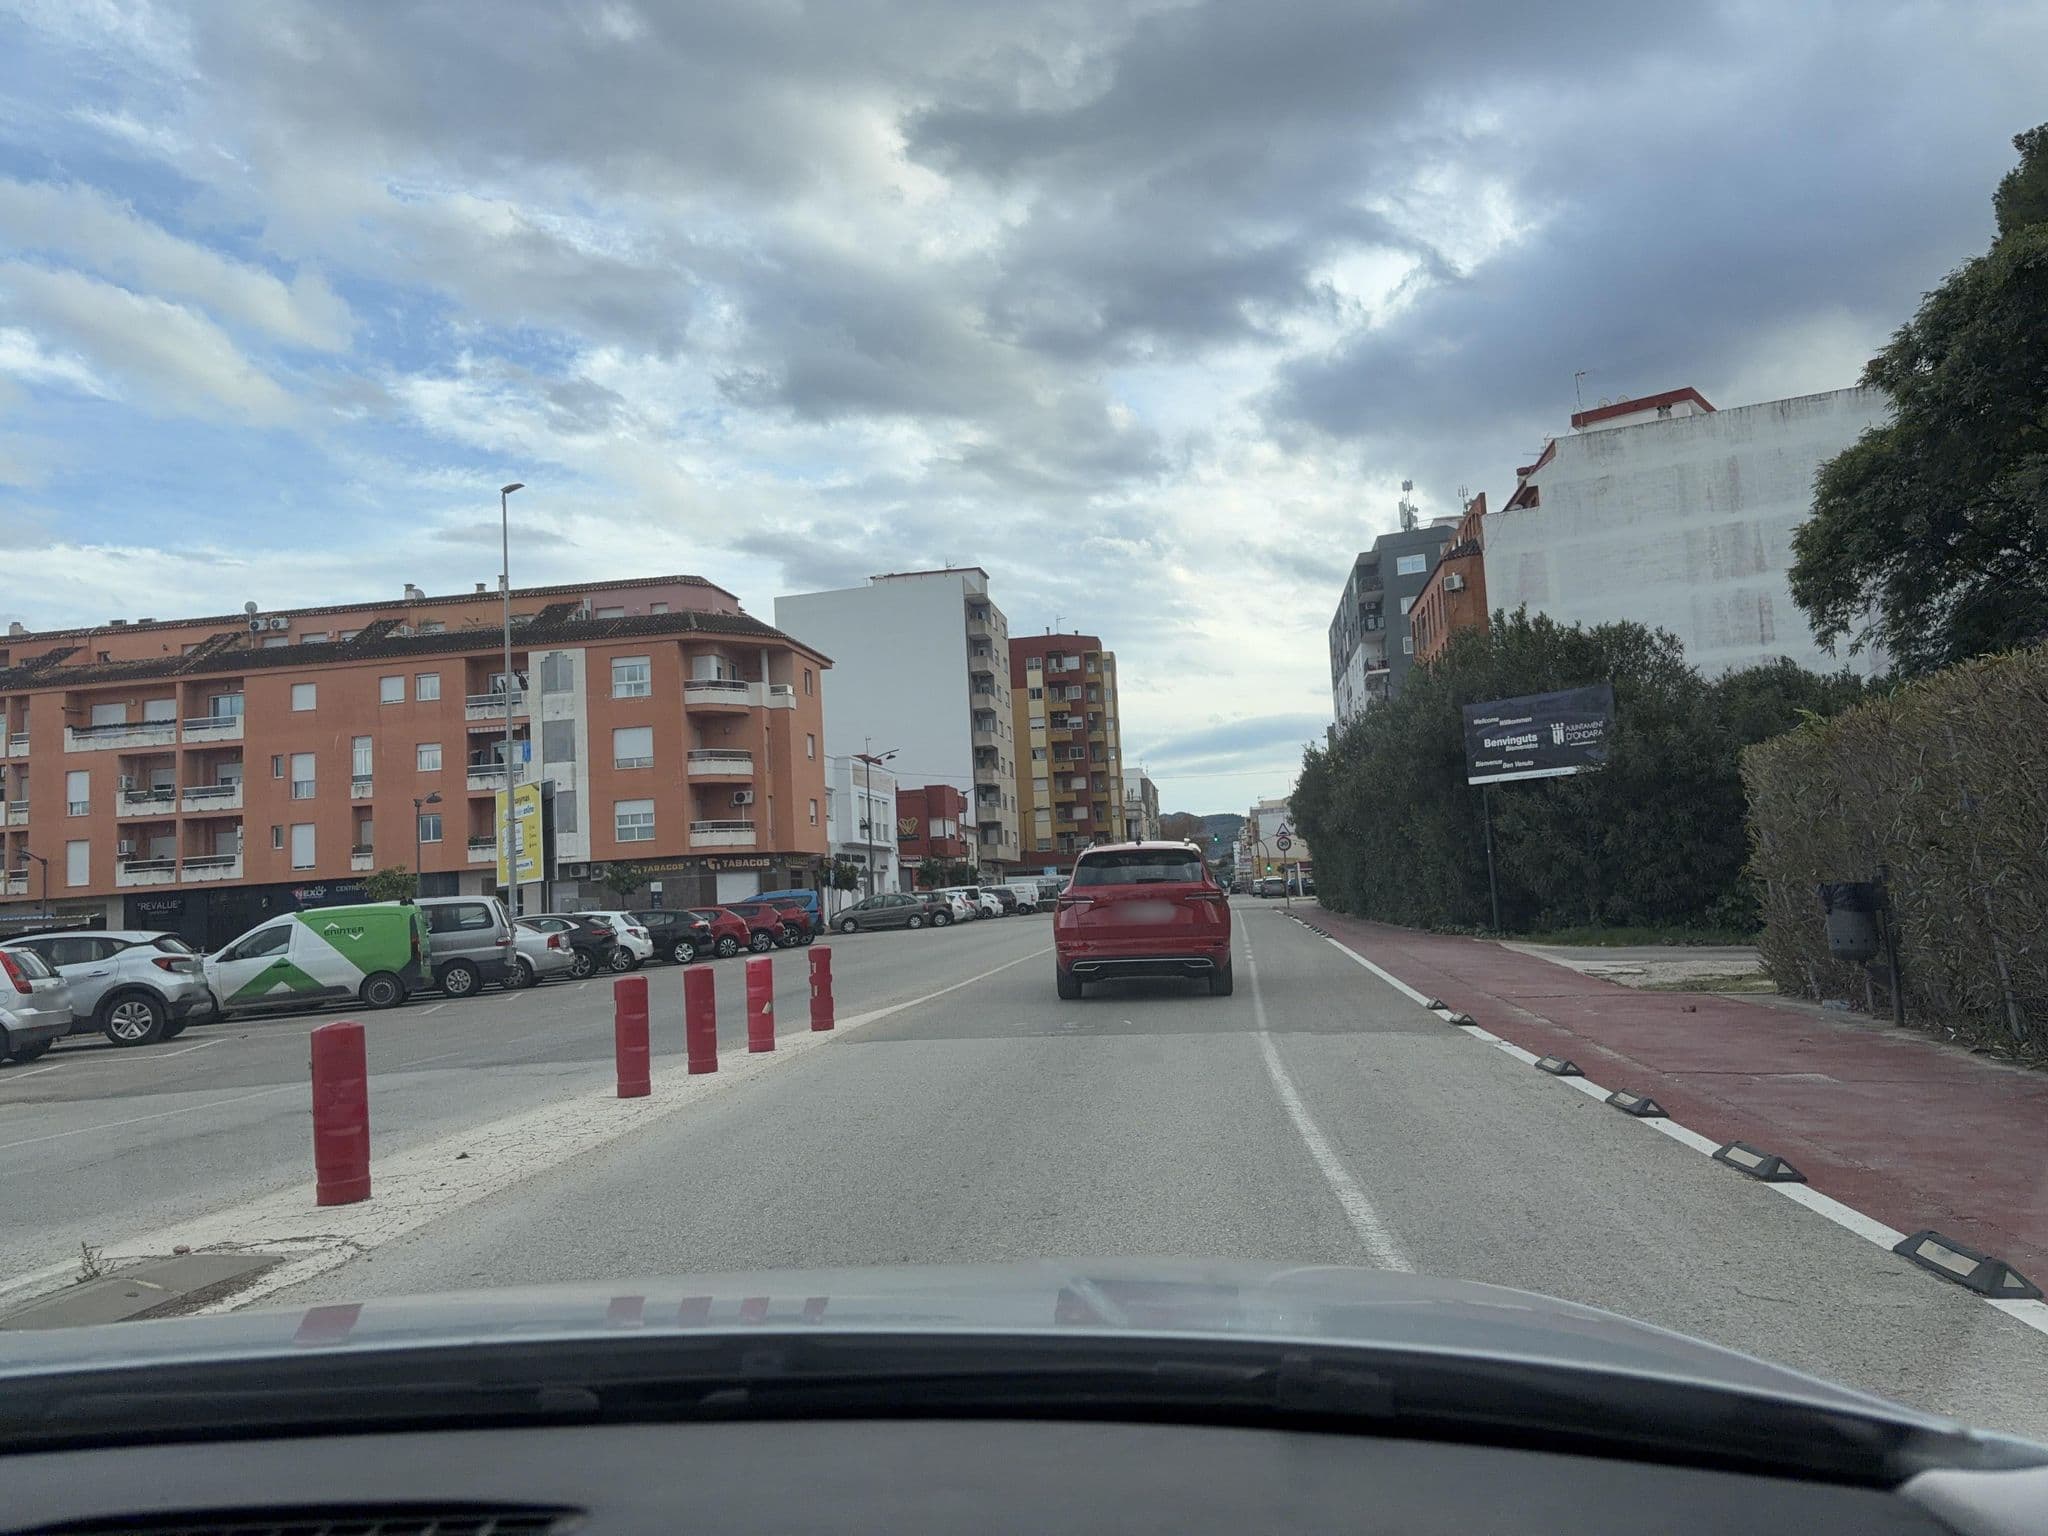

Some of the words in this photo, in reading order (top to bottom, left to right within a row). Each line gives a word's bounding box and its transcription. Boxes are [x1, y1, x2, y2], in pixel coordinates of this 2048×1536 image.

[1565, 720, 1604, 732] AJUNTAMENT
[1484, 733, 1538, 748] Benvinguts
[642, 863, 685, 873] TABACOS
[722, 858, 771, 868] TABACOS
[295, 884, 325, 899] NEXO
